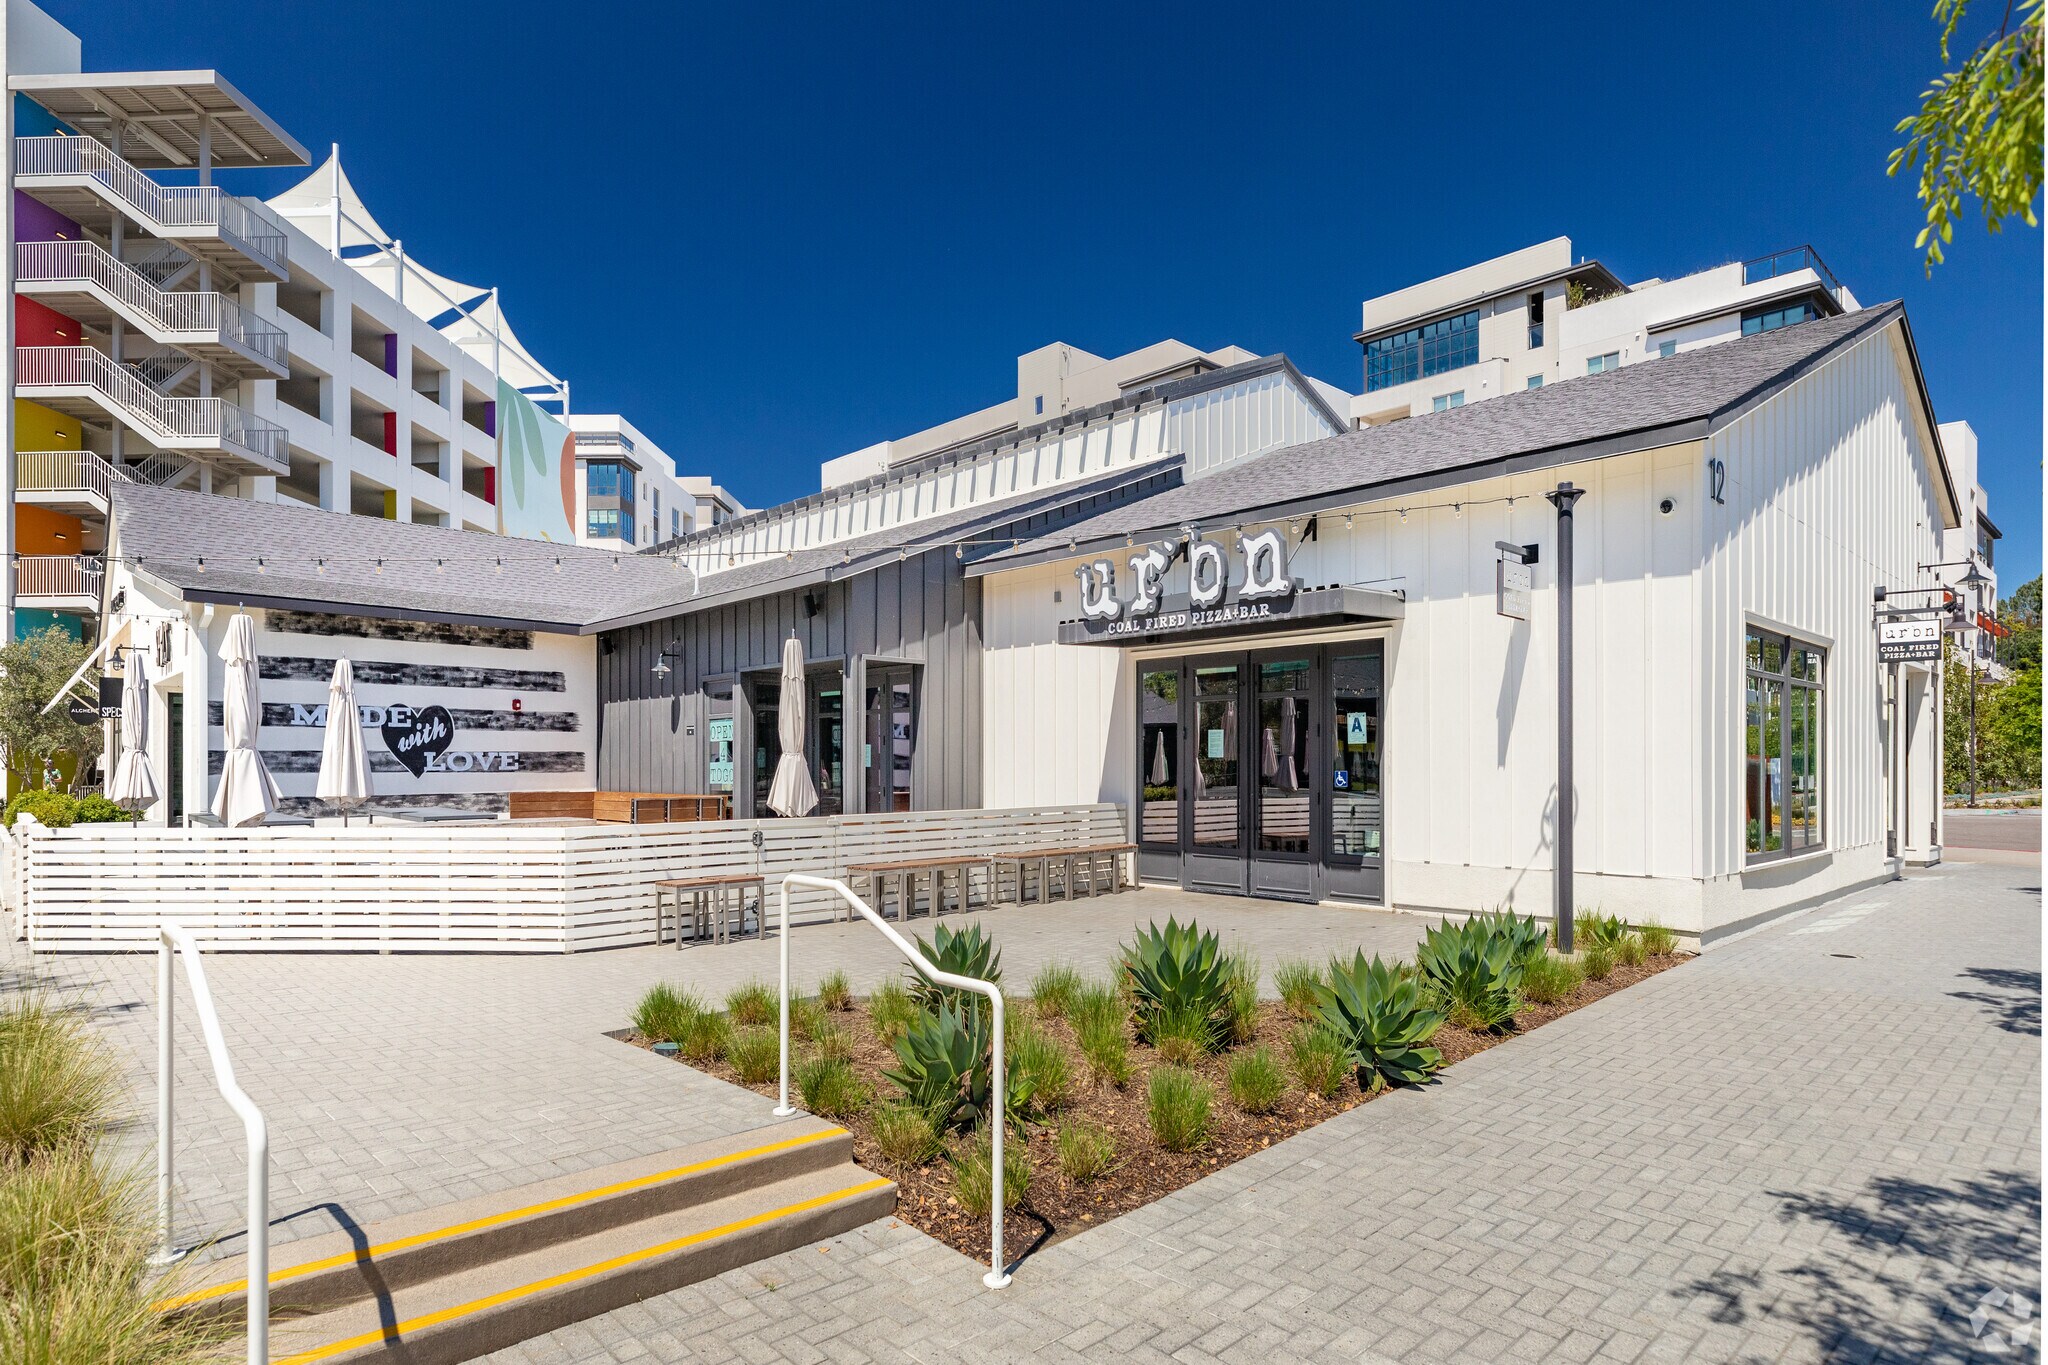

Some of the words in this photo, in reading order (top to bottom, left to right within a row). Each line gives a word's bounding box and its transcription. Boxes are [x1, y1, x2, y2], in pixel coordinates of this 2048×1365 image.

[1708, 458, 1725, 505] 12
[1075, 523, 1294, 619] urbn
[1108, 619, 1140, 634] COAL
[1145, 613, 1186, 631] FIRED
[1192, 603, 1270, 625] PIZZA+BAR
[1884, 651, 1936, 659] PIZZA+BAR
[290, 703, 412, 728] MDE
[1351, 717, 1363, 733] A
[397, 716, 447, 752] with
[424, 751, 519, 772] LOVE
